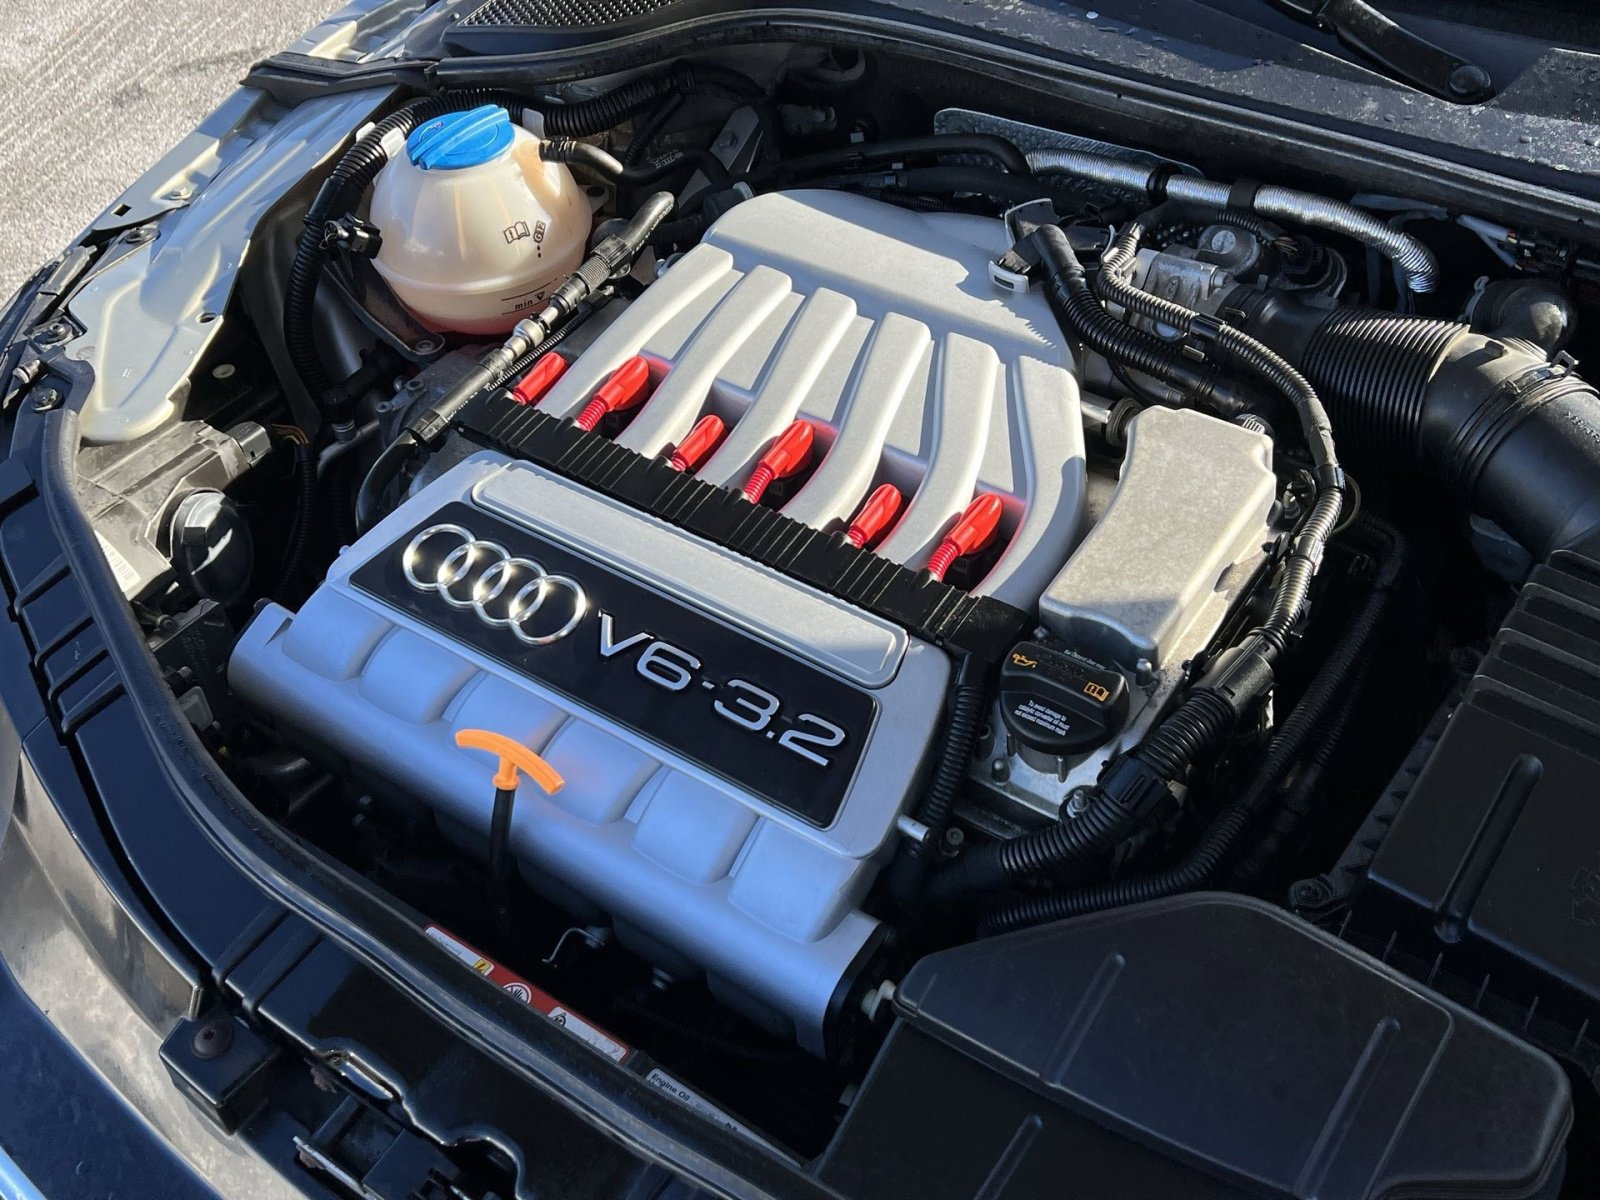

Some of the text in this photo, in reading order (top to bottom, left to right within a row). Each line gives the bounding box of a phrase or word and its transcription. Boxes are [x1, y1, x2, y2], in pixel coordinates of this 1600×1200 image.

[514, 299, 533, 310] min
[652, 1073, 691, 1102] Engine Oil
